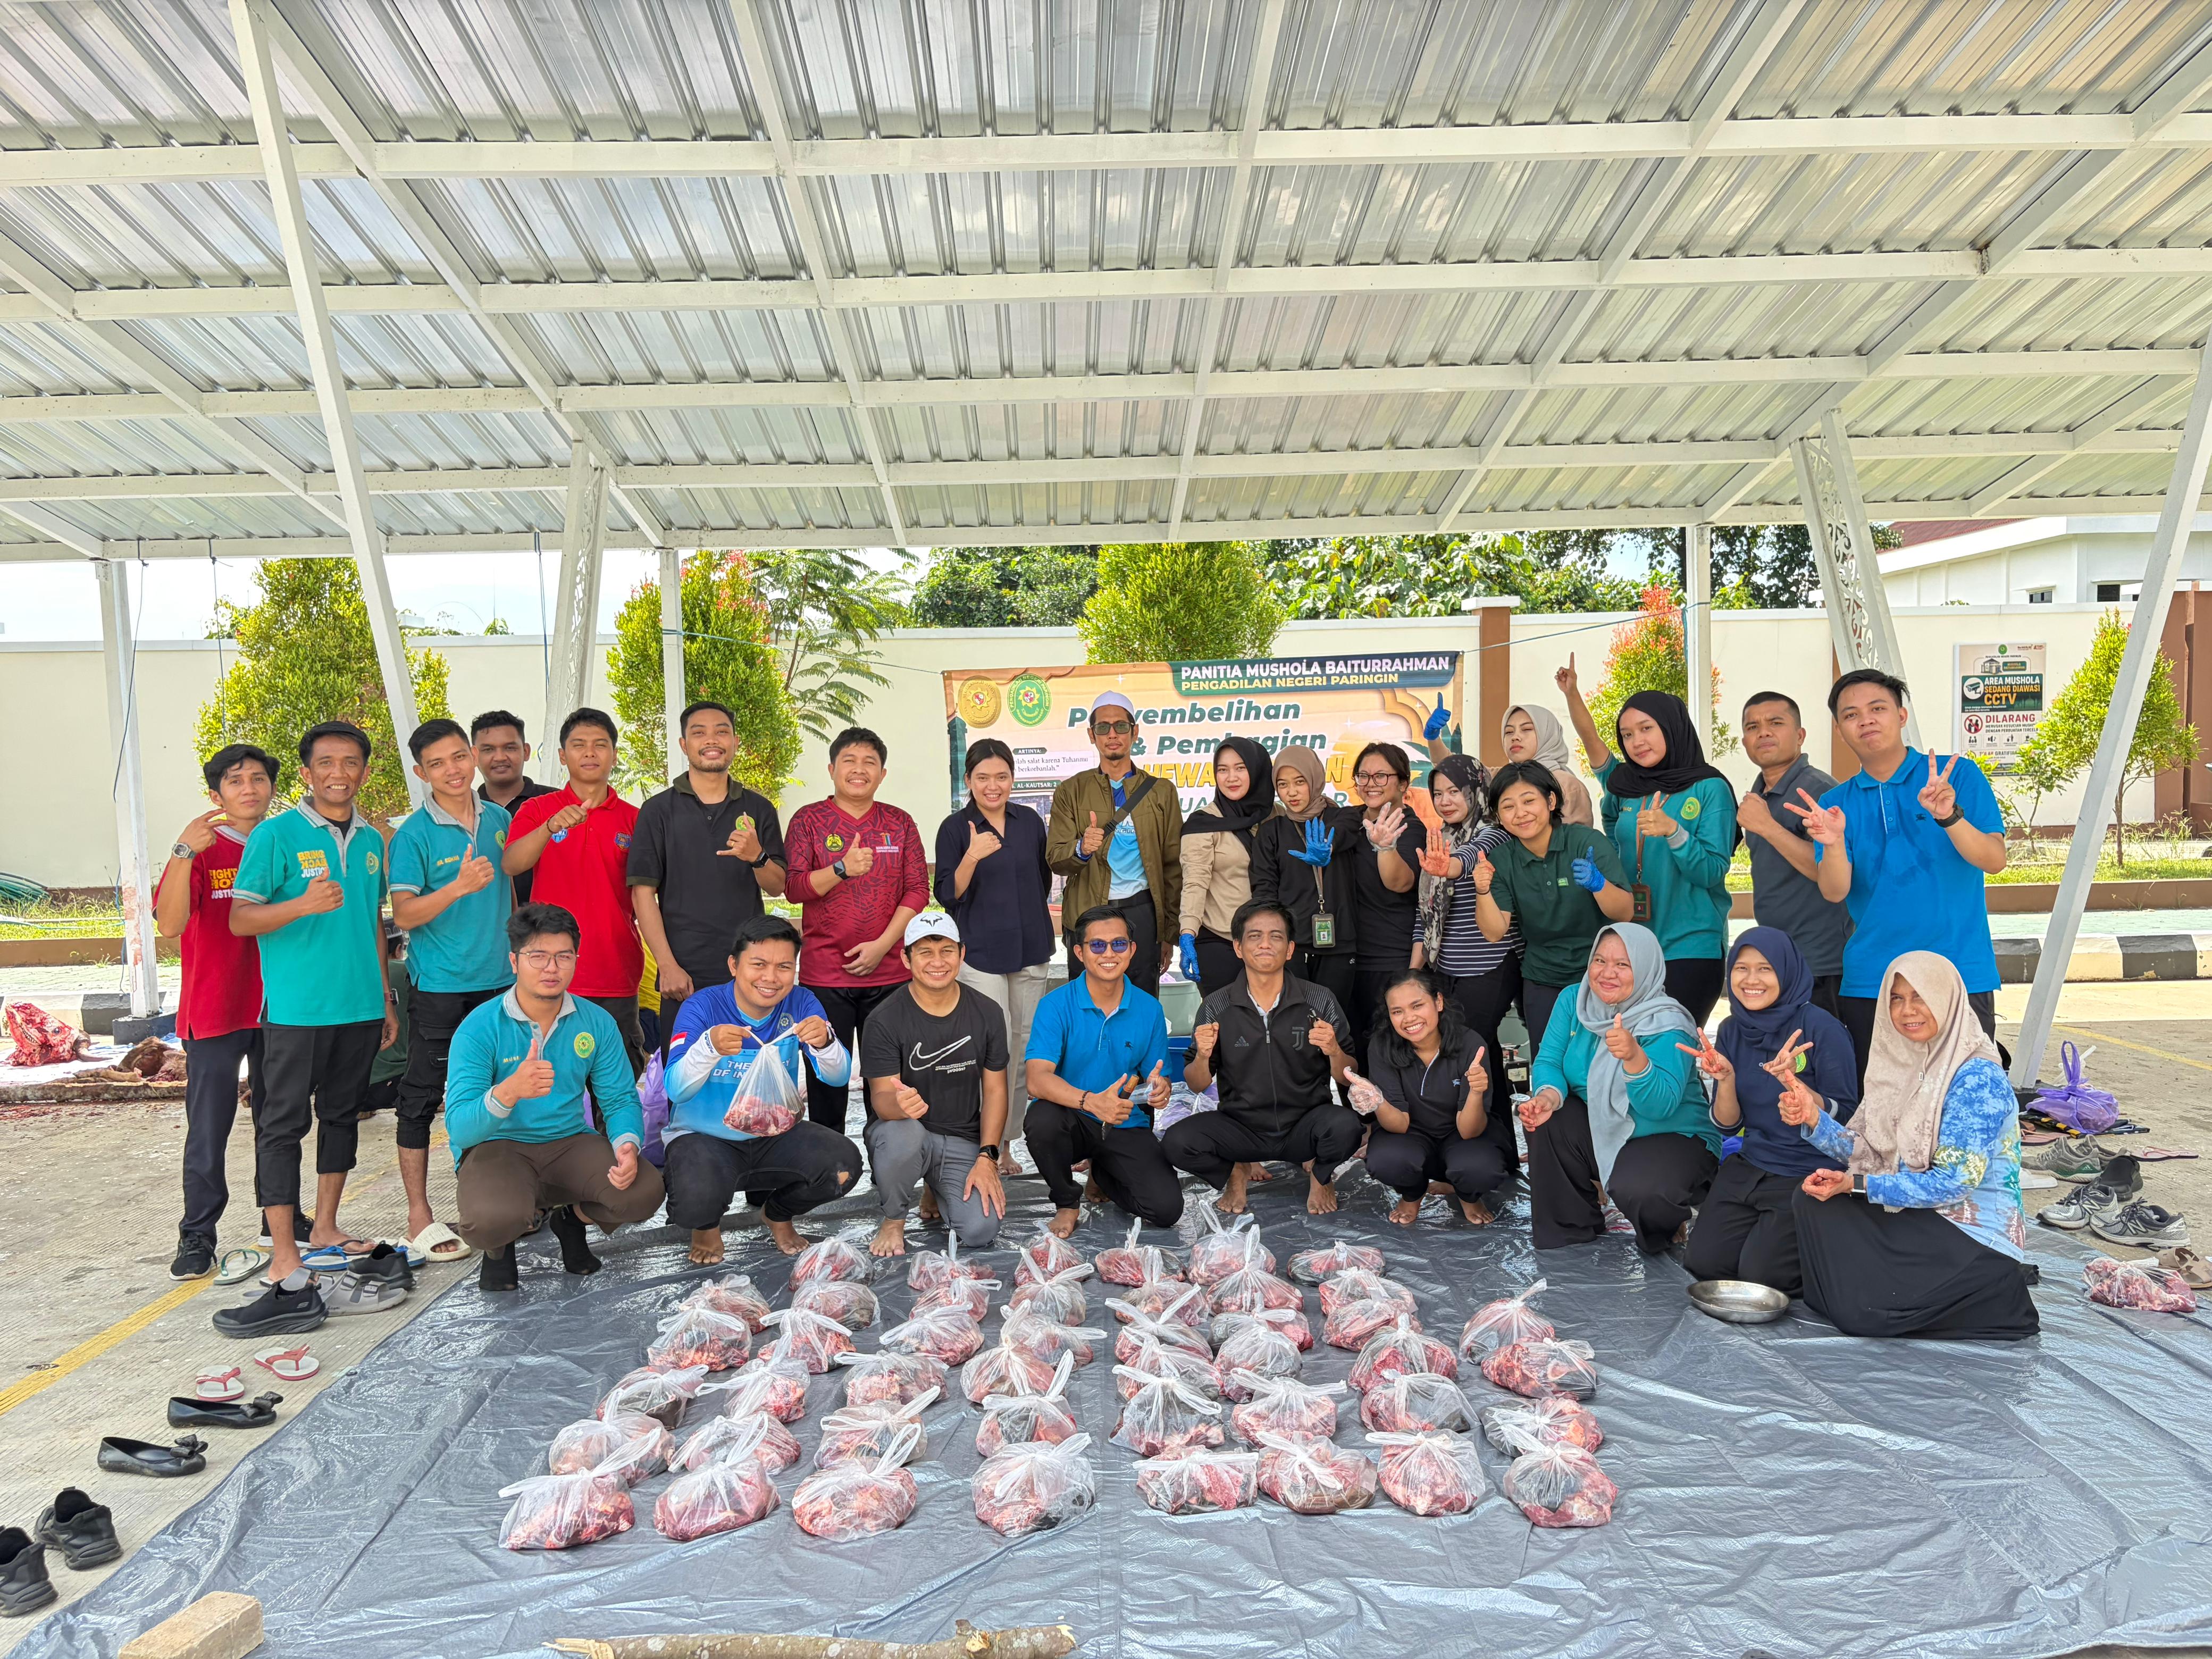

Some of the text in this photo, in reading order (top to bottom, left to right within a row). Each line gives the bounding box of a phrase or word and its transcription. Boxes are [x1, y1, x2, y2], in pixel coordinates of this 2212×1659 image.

[1182, 657, 1449, 680] PANITIA MUSHOLA BAITURRAHMAN
[1182, 674, 1398, 691] PENGADILAN NEGERI PARINGIN
[2005, 676, 2040, 684] MUSHOLA
[1984, 693, 2017, 705] CCTV
[1985, 714, 2035, 723] DILARANG
[1157, 728, 1327, 756] Pemgian
[297, 850, 325, 861] BRING
[301, 867, 325, 878] JUSTIC
[211, 889, 234, 899] JUSTIC
[727, 1060, 751, 1071] THE
[713, 1069, 731, 1077] OF
